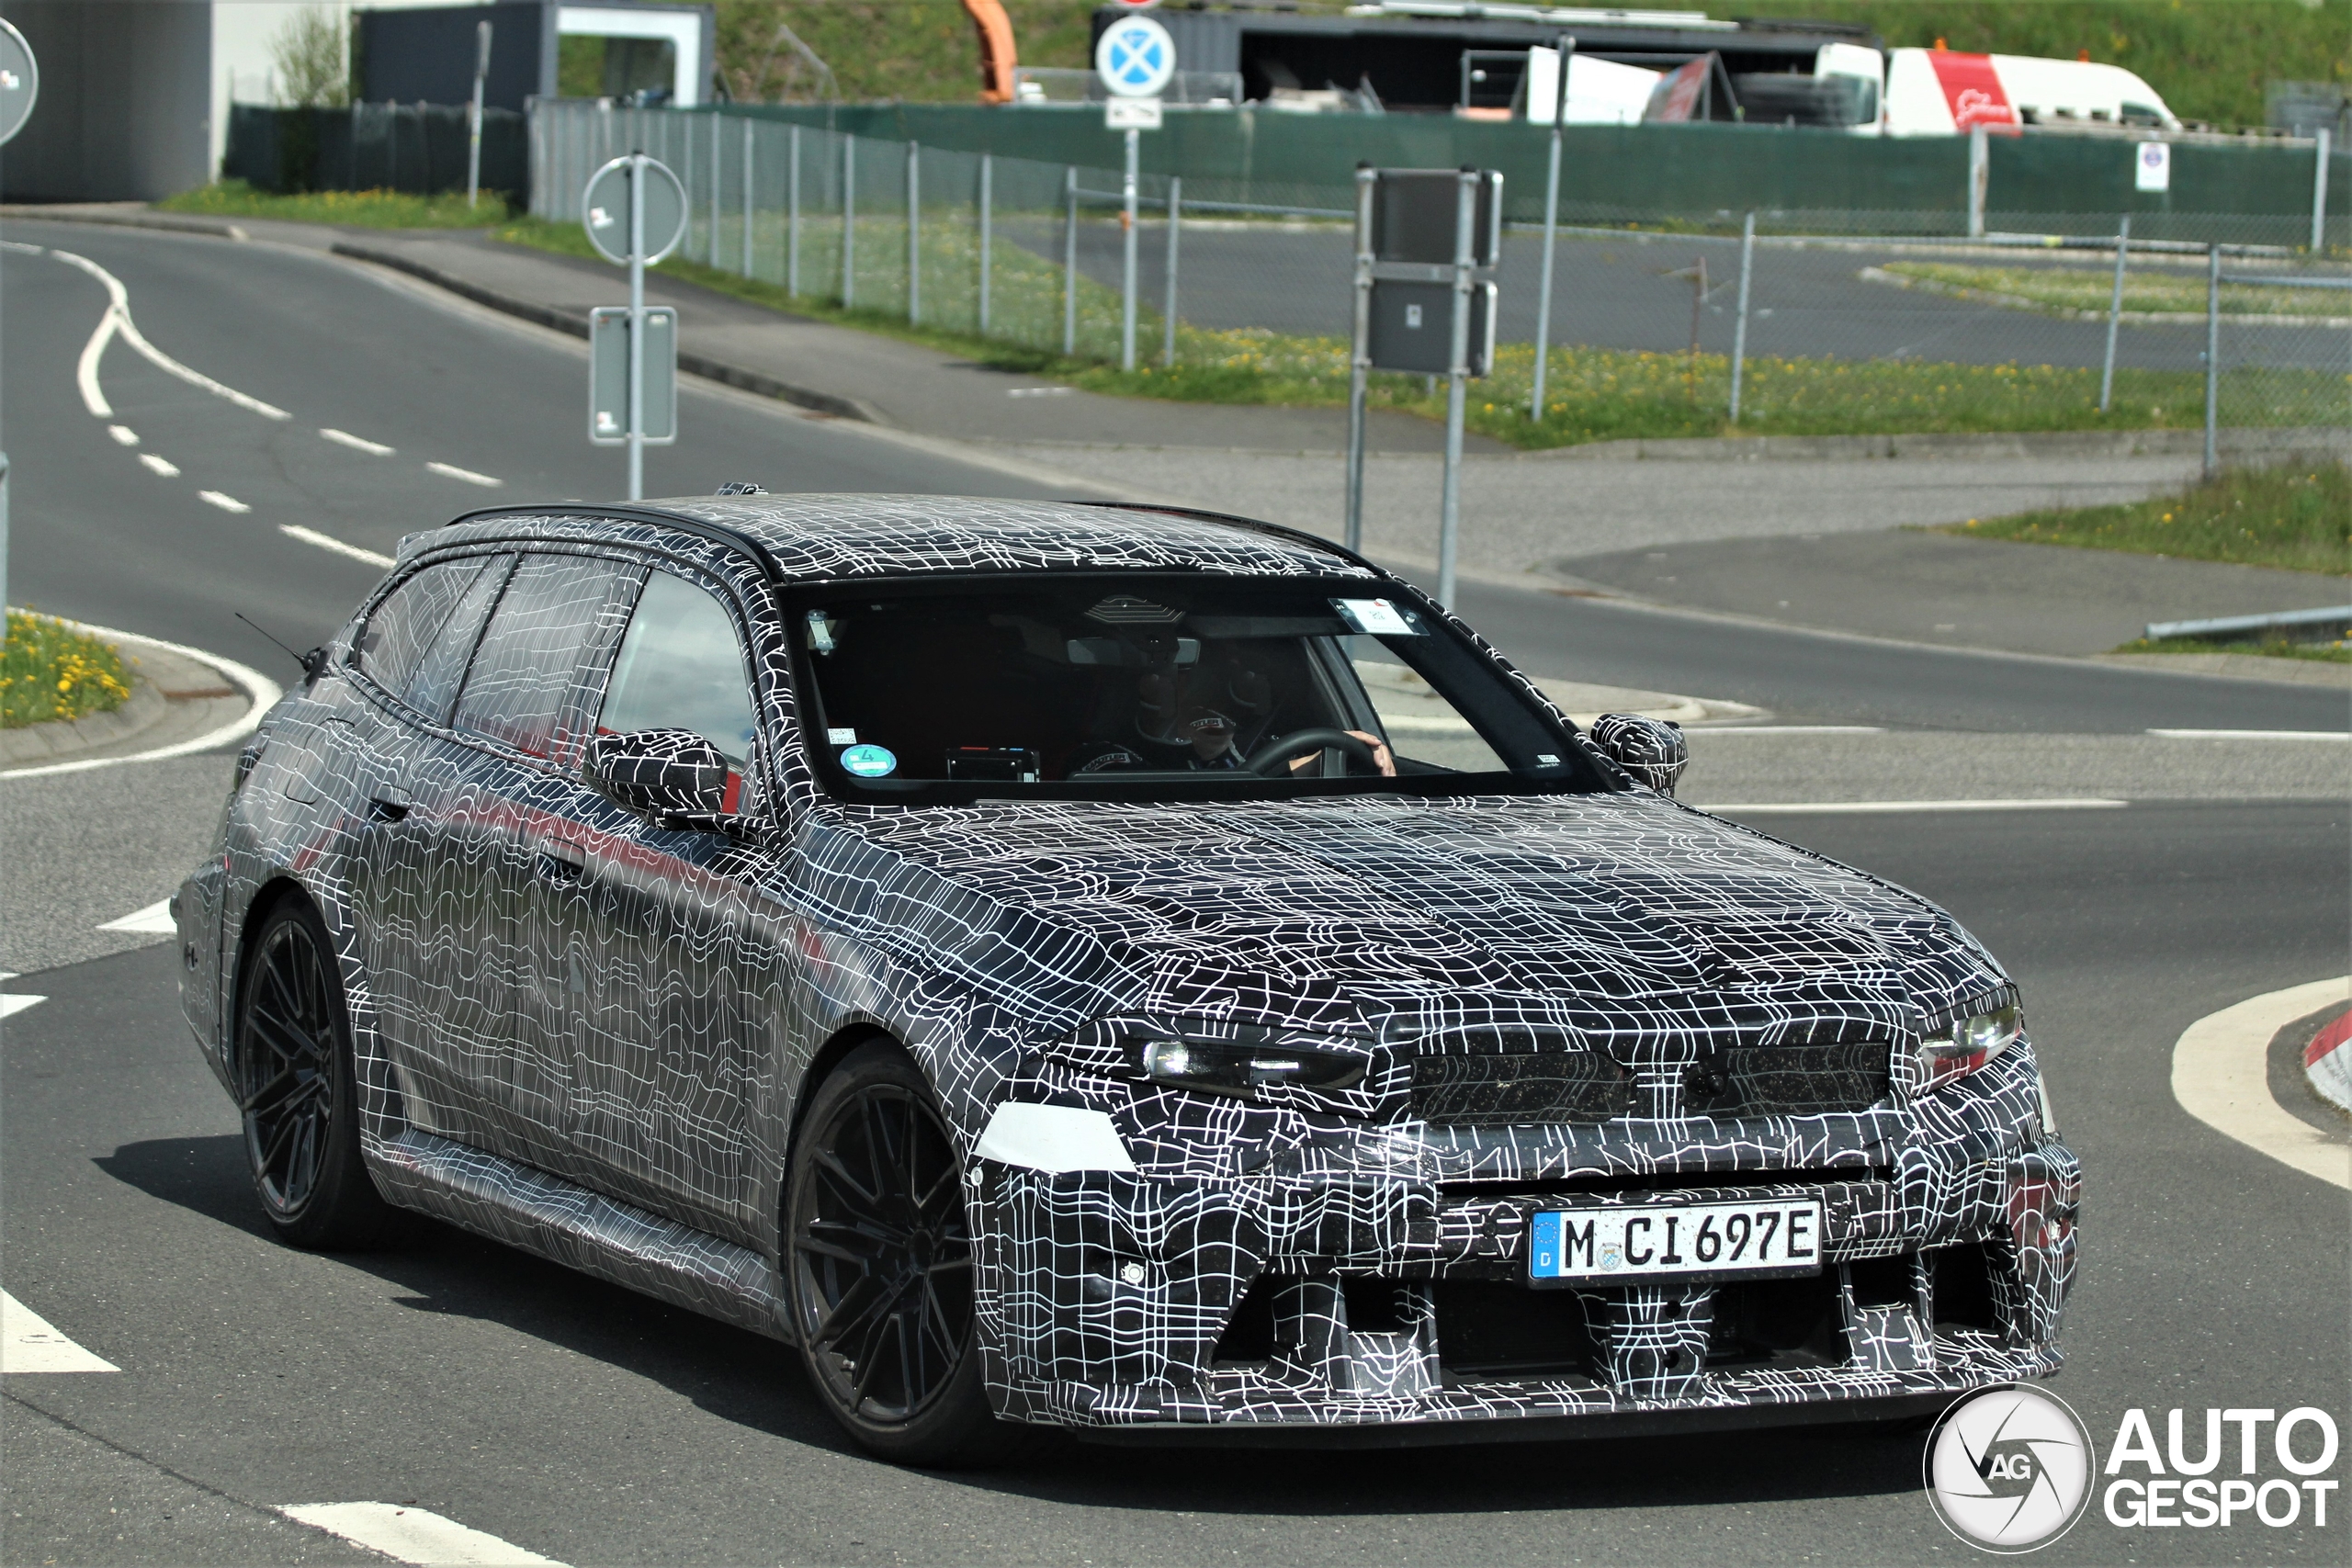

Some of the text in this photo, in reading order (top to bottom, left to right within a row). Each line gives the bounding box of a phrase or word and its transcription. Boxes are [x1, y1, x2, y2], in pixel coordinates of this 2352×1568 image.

[862, 750, 874, 761] 4
[1566, 1219, 1595, 1268] M
[1540, 1252, 1551, 1267] D
